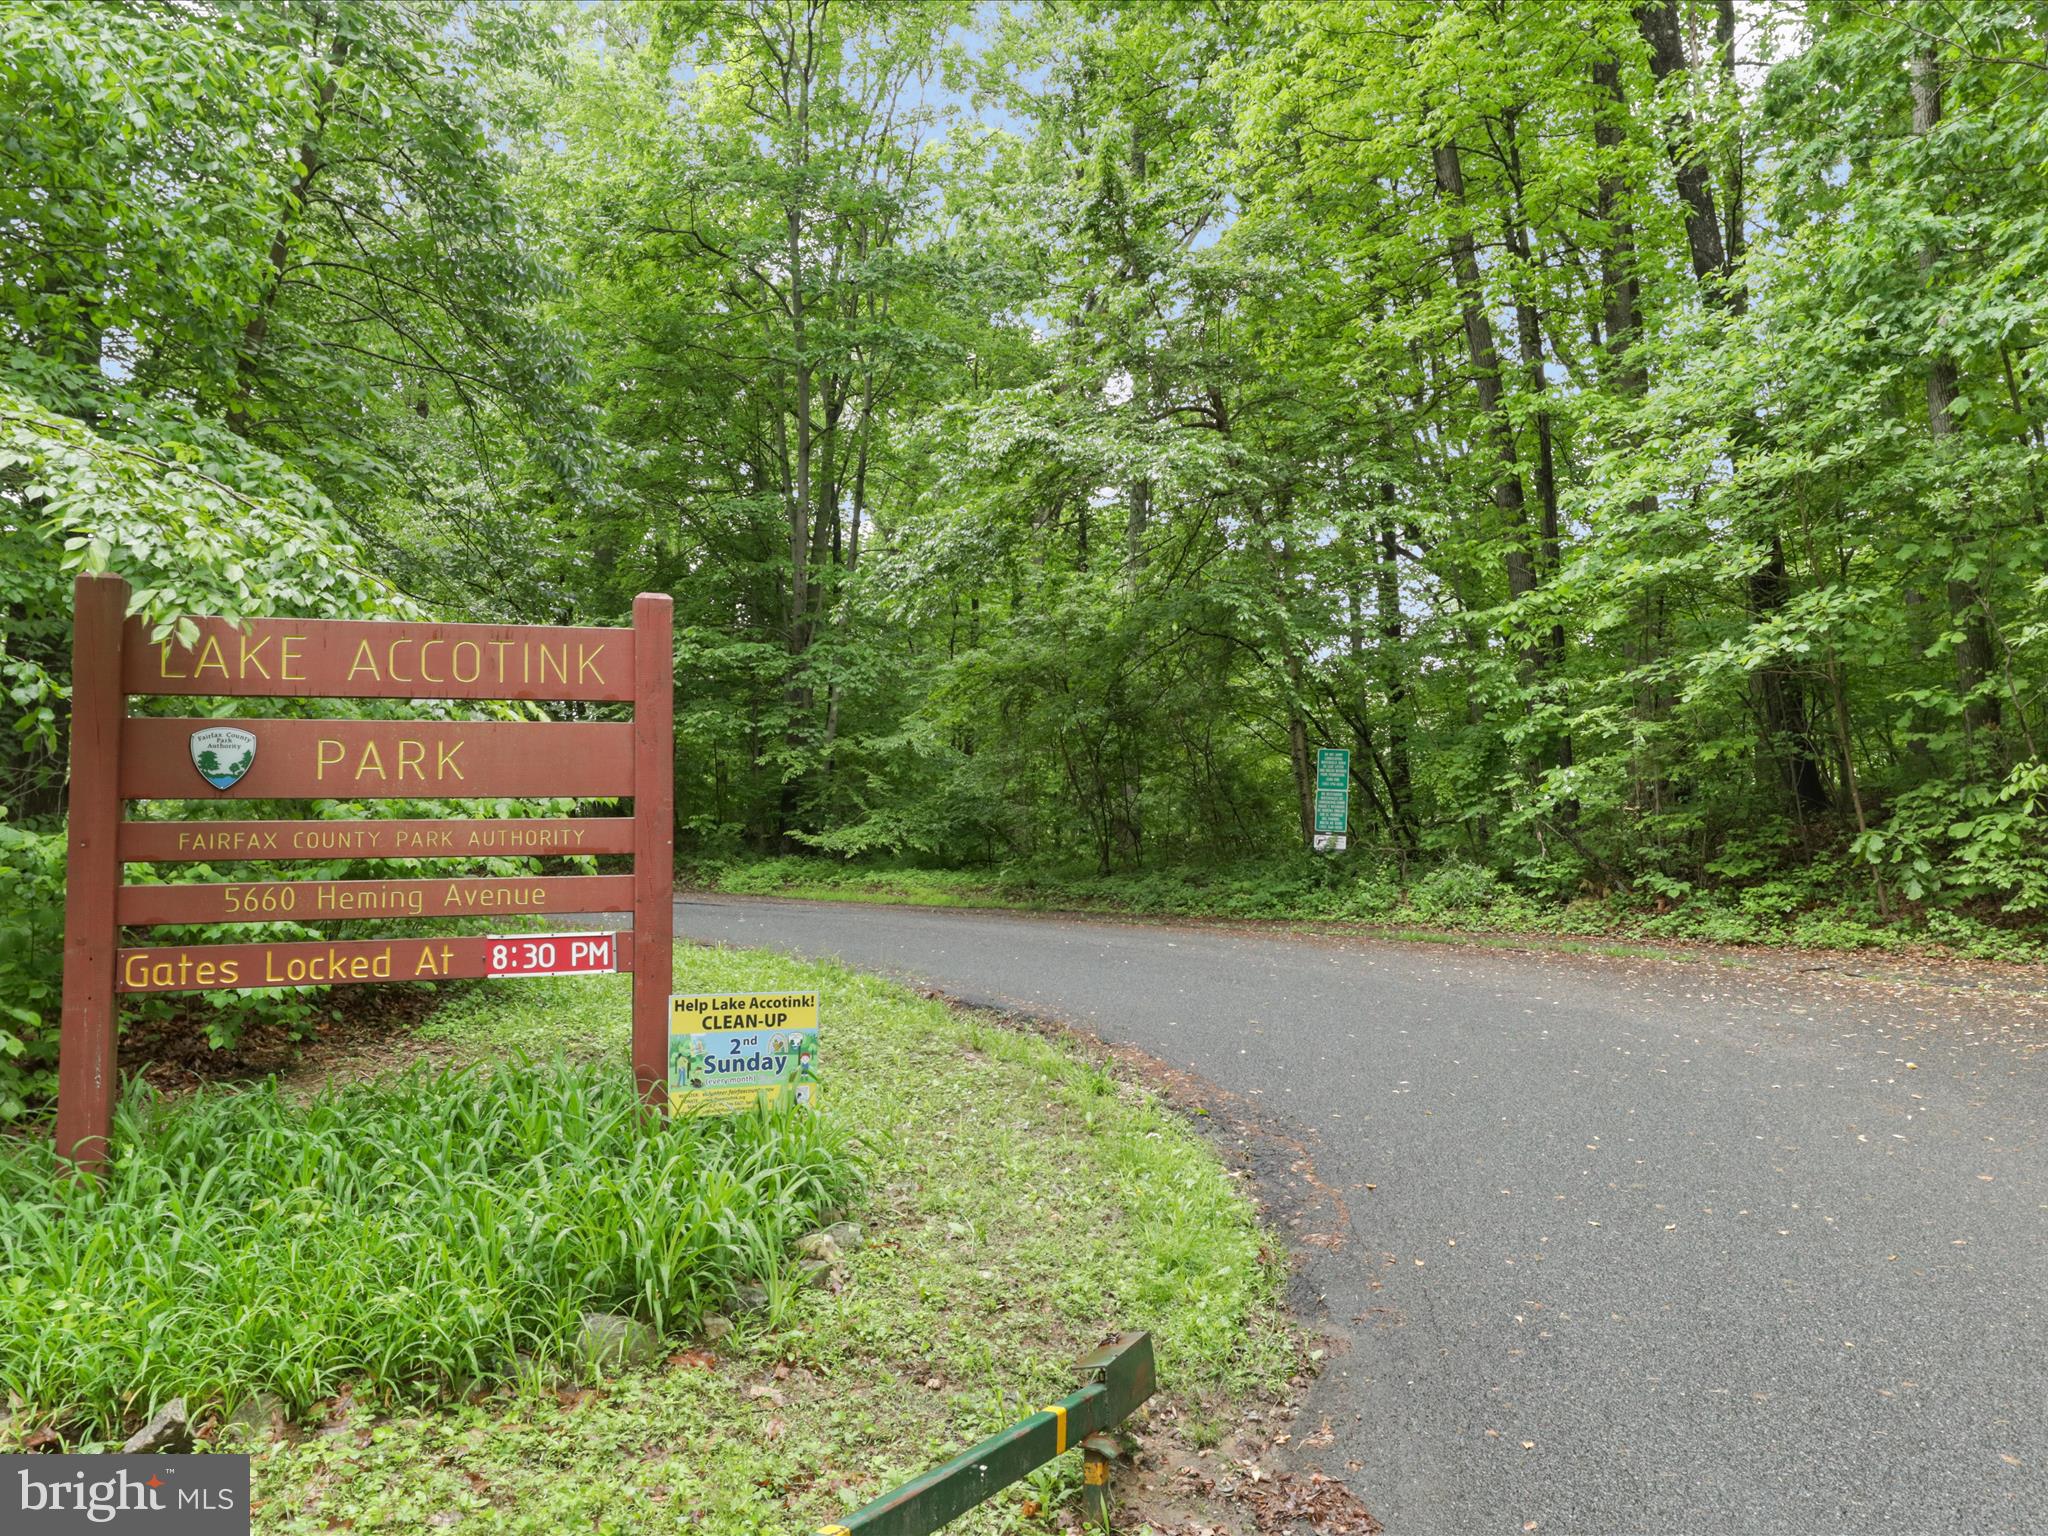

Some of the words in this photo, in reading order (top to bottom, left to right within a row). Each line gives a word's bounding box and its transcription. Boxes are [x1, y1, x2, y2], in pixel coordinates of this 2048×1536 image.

[161, 634, 307, 680] LAKE
[348, 639, 605, 685] ACCOTINK
[197, 732, 223, 741] Fairfax
[226, 732, 252, 743] County
[317, 740, 465, 780] PARK
[178, 832, 278, 850] FAIRFAX
[293, 831, 381, 849] COUNTY
[396, 831, 453, 848] PARK
[468, 829, 585, 847] AUTHORITY
[224, 886, 296, 913] 5660
[318, 884, 423, 915] Heming
[444, 883, 546, 907] Avenue
[125, 953, 239, 988] Gates
[266, 947, 391, 982] Locked
[415, 944, 454, 976] At
[492, 943, 556, 970] 8:30
[571, 940, 609, 967] PM
[674, 999, 708, 1014] Help
[712, 998, 746, 1011] Lake
[750, 995, 815, 1010] Accotink!
[702, 1013, 788, 1030] CLEAN-UP
[730, 1036, 758, 1055] 2nd
[704, 1052, 787, 1075] Sunday
